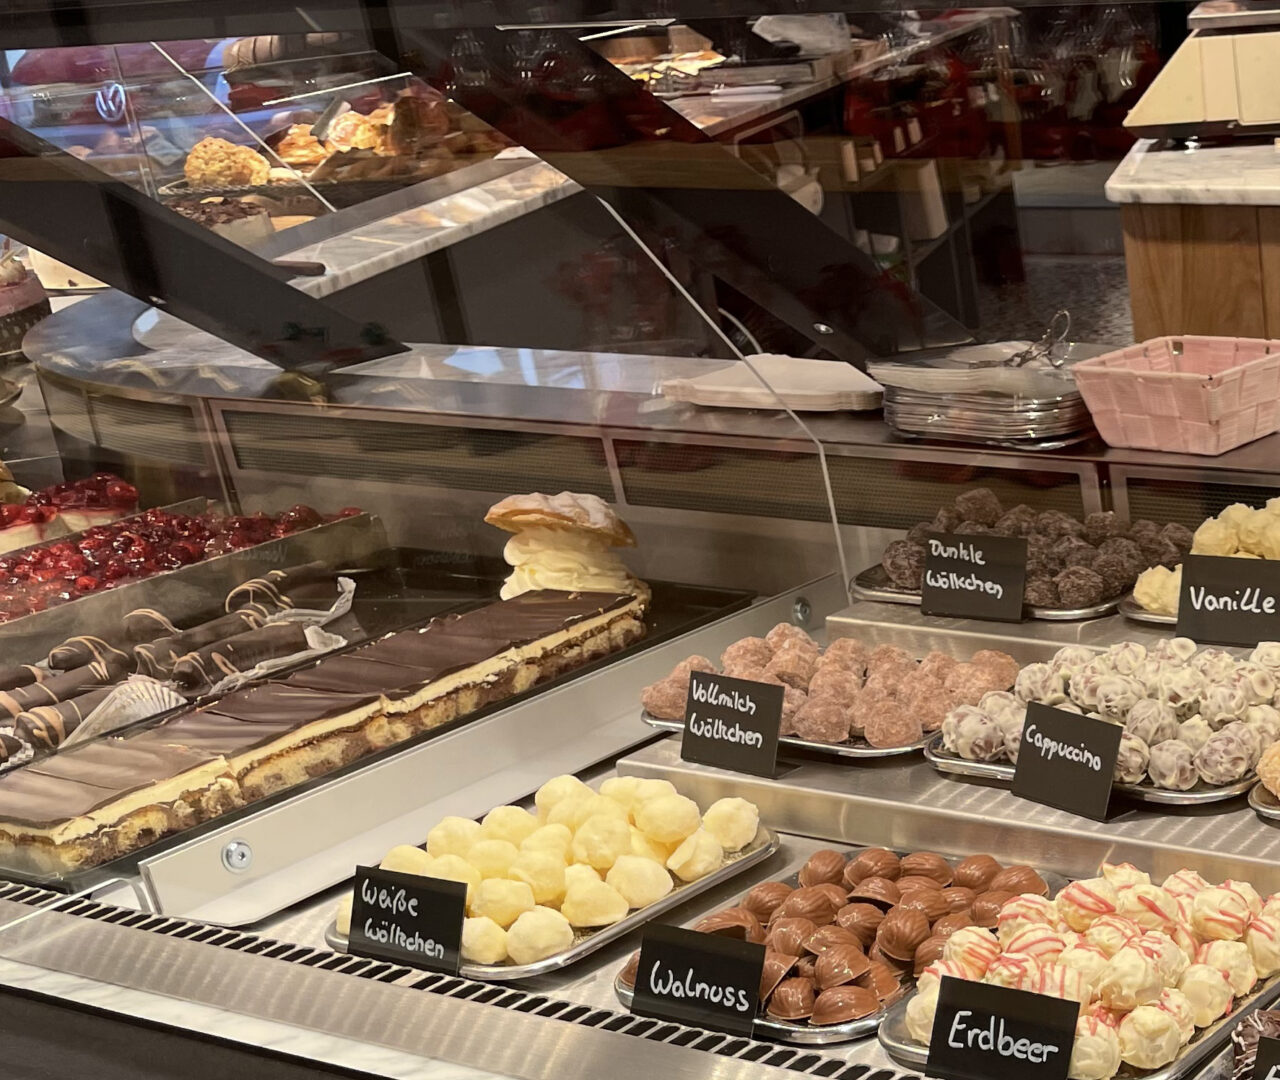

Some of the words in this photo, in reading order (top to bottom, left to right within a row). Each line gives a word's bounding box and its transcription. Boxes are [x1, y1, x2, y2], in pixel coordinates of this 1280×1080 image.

[928, 539, 986, 565] Dunkle
[1189, 586, 1276, 614] Vanille
[693, 679, 756, 715] Vollmilch
[1026, 724, 1101, 771] Cappuccino
[362, 879, 418, 917] Weiße
[650, 960, 749, 1011] Walnuss
[948, 1011, 1059, 1063] Erdbeer
